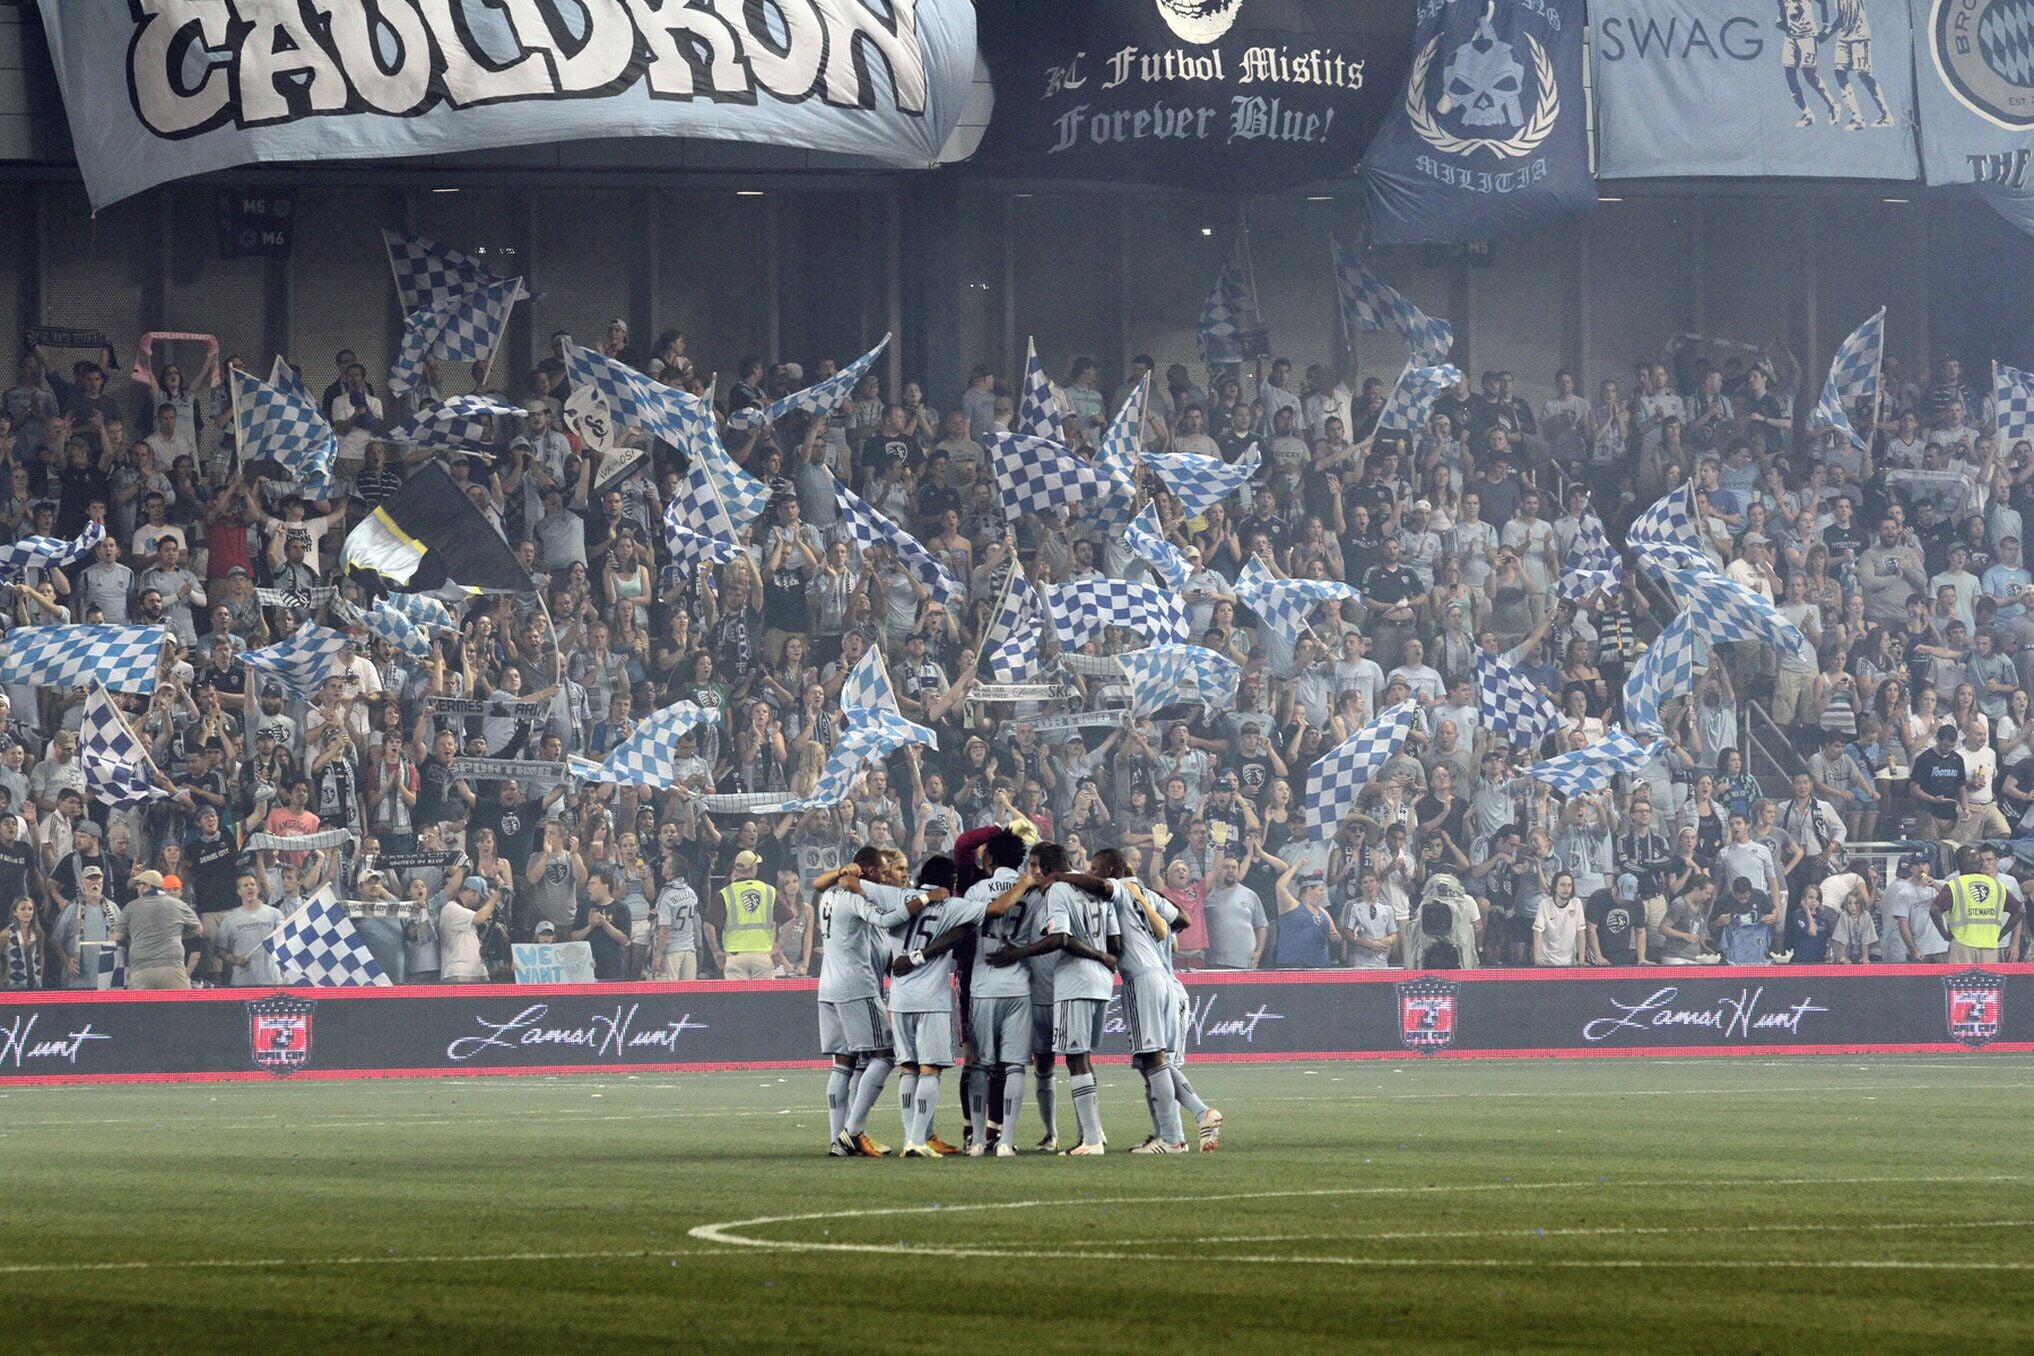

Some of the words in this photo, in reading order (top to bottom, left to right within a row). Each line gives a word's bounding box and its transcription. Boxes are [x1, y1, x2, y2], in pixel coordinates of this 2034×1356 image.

[1600, 16, 1763, 61] SWAG
[127, 0, 928, 140] CAULDRON
[1101, 45, 1225, 90] Futbol
[1239, 46, 1365, 90] Misfits
[1047, 100, 1217, 154] Forever
[1227, 95, 1335, 145] Blue!
[1415, 155, 1547, 193] MILITIA
[263, 231, 284, 245] M6
[1967, 907, 1996, 917] STEWARD
[515, 945, 552, 967] WE
[515, 965, 562, 984] WANT
[592, 1003, 708, 1056] Hunt
[1718, 986, 1828, 1037] Hunt
